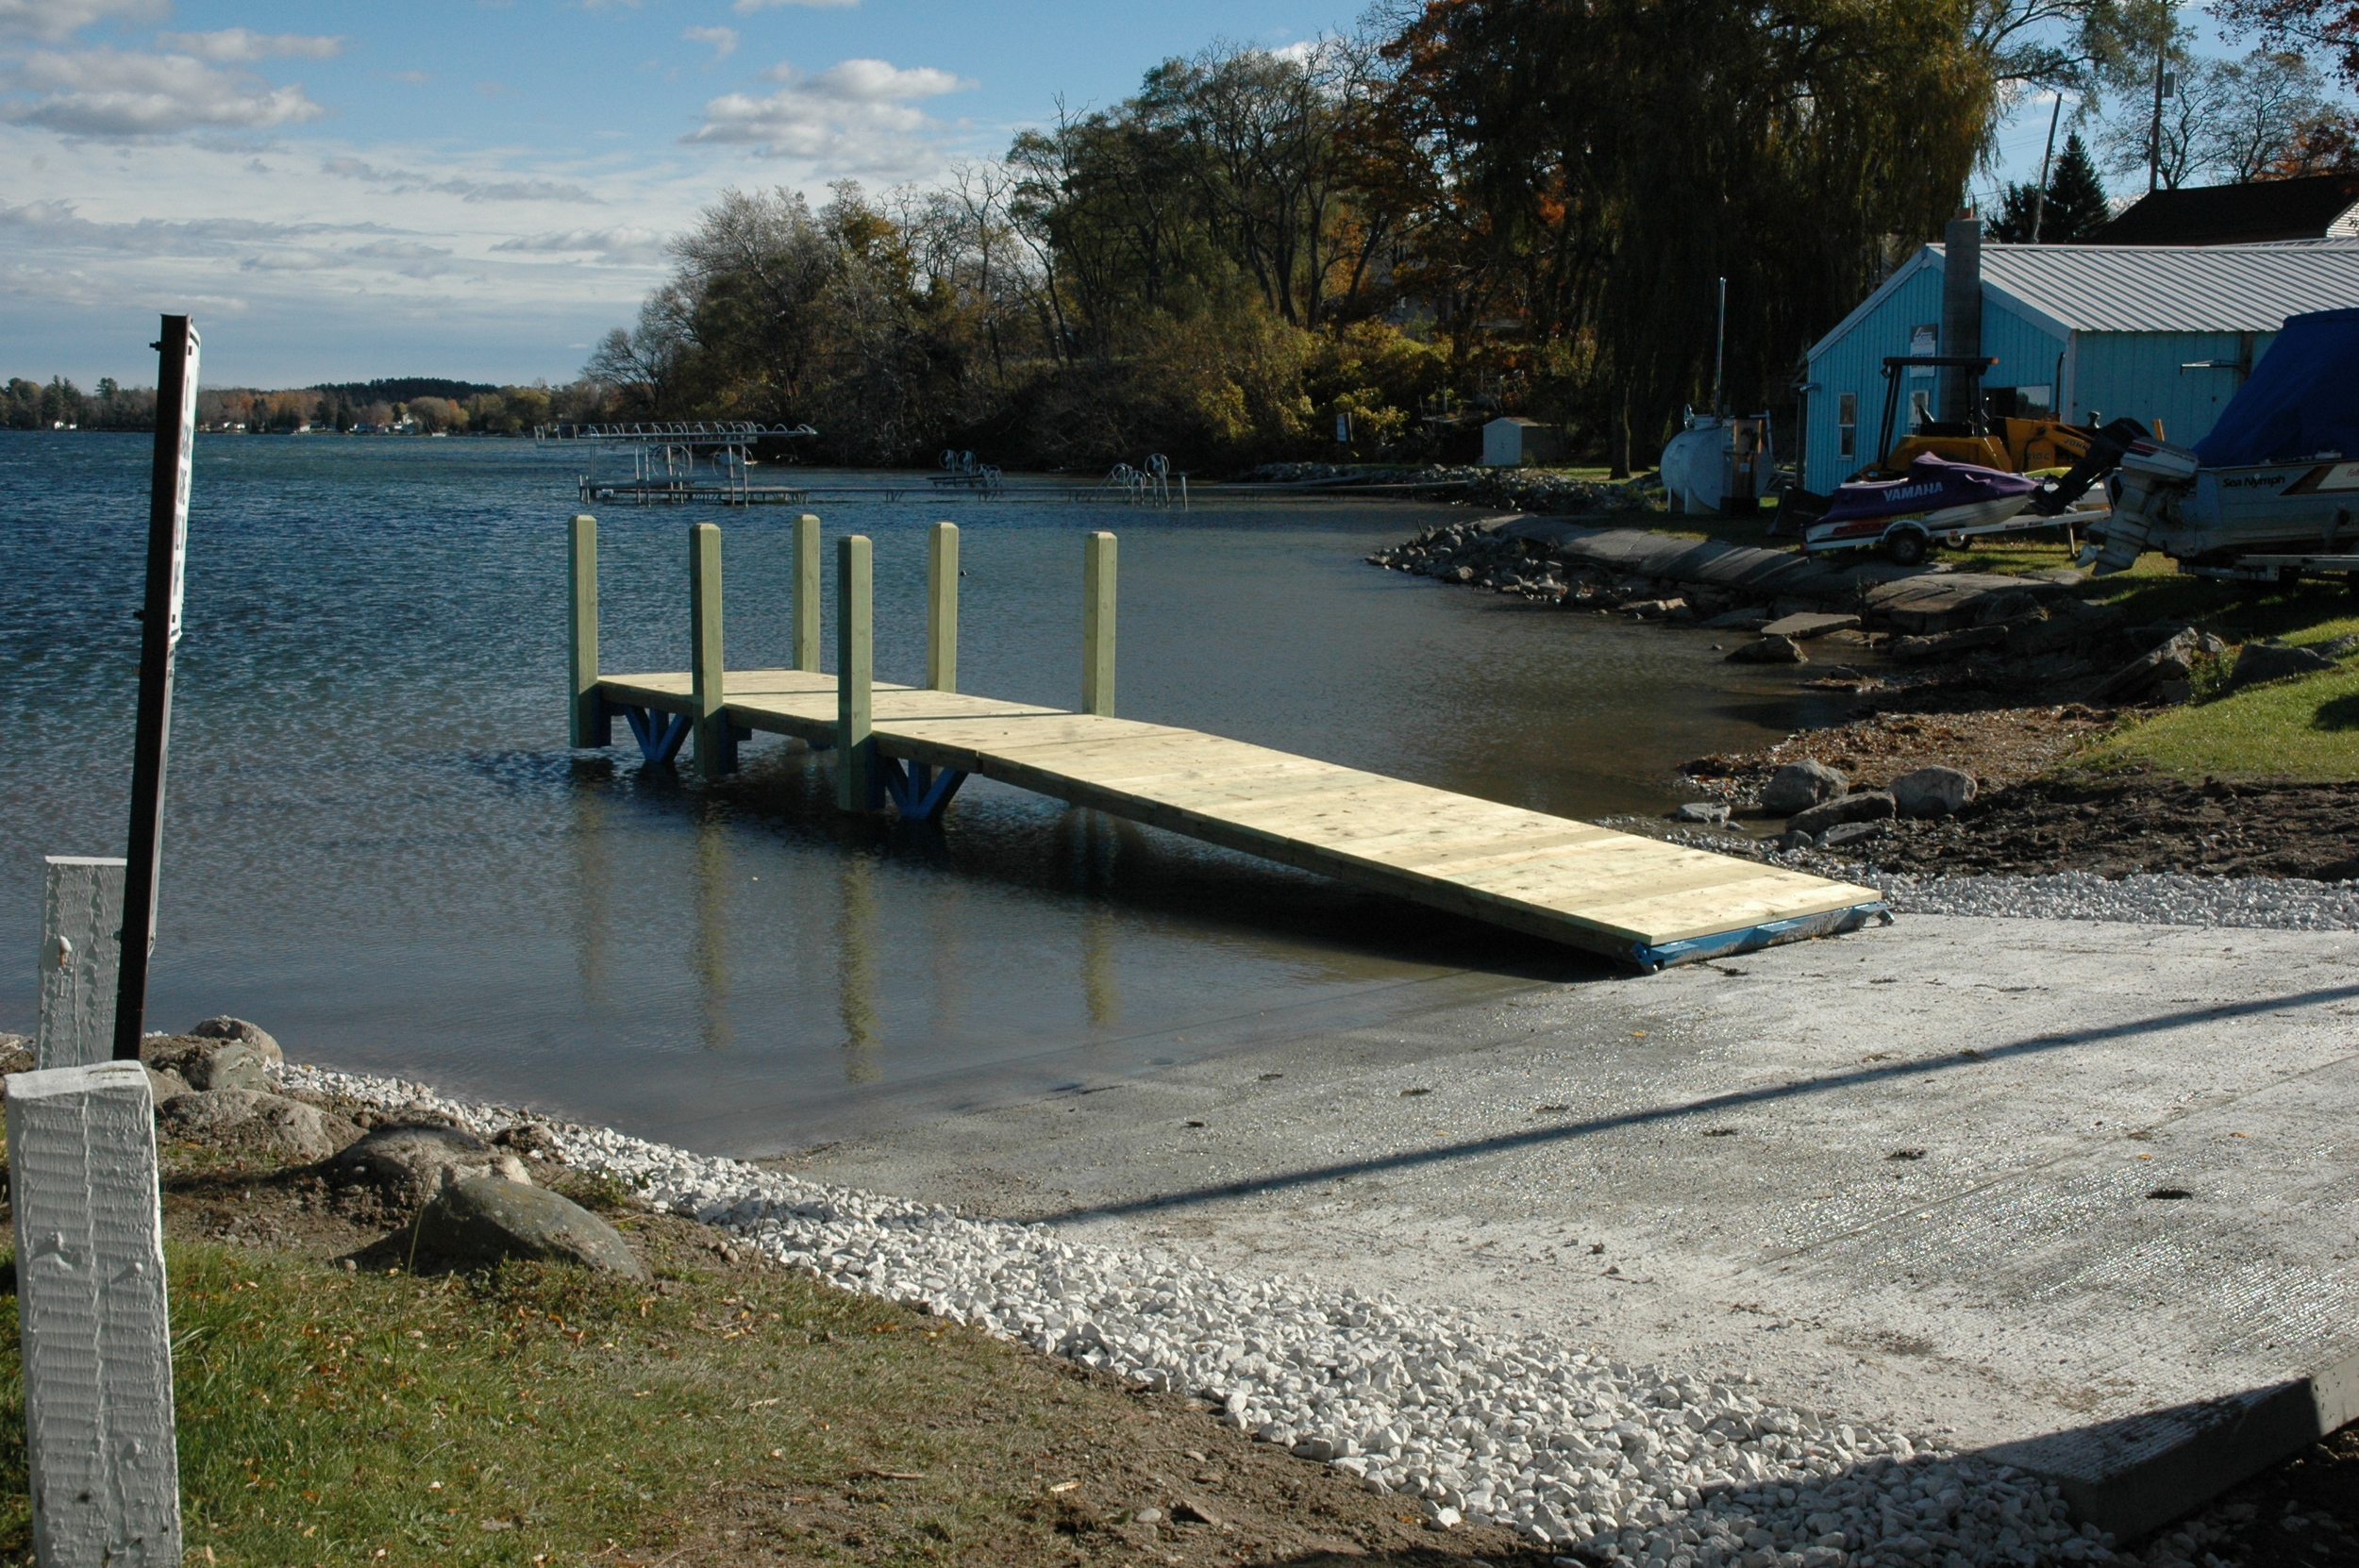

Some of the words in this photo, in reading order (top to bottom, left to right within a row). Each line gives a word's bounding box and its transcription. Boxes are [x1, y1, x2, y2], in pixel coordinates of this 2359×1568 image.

[2064, 438, 2089, 451] JOHN
[2223, 478, 2242, 488] Sea
[2244, 475, 2285, 489] Nymph
[1882, 481, 1944, 503] YAMAHA
